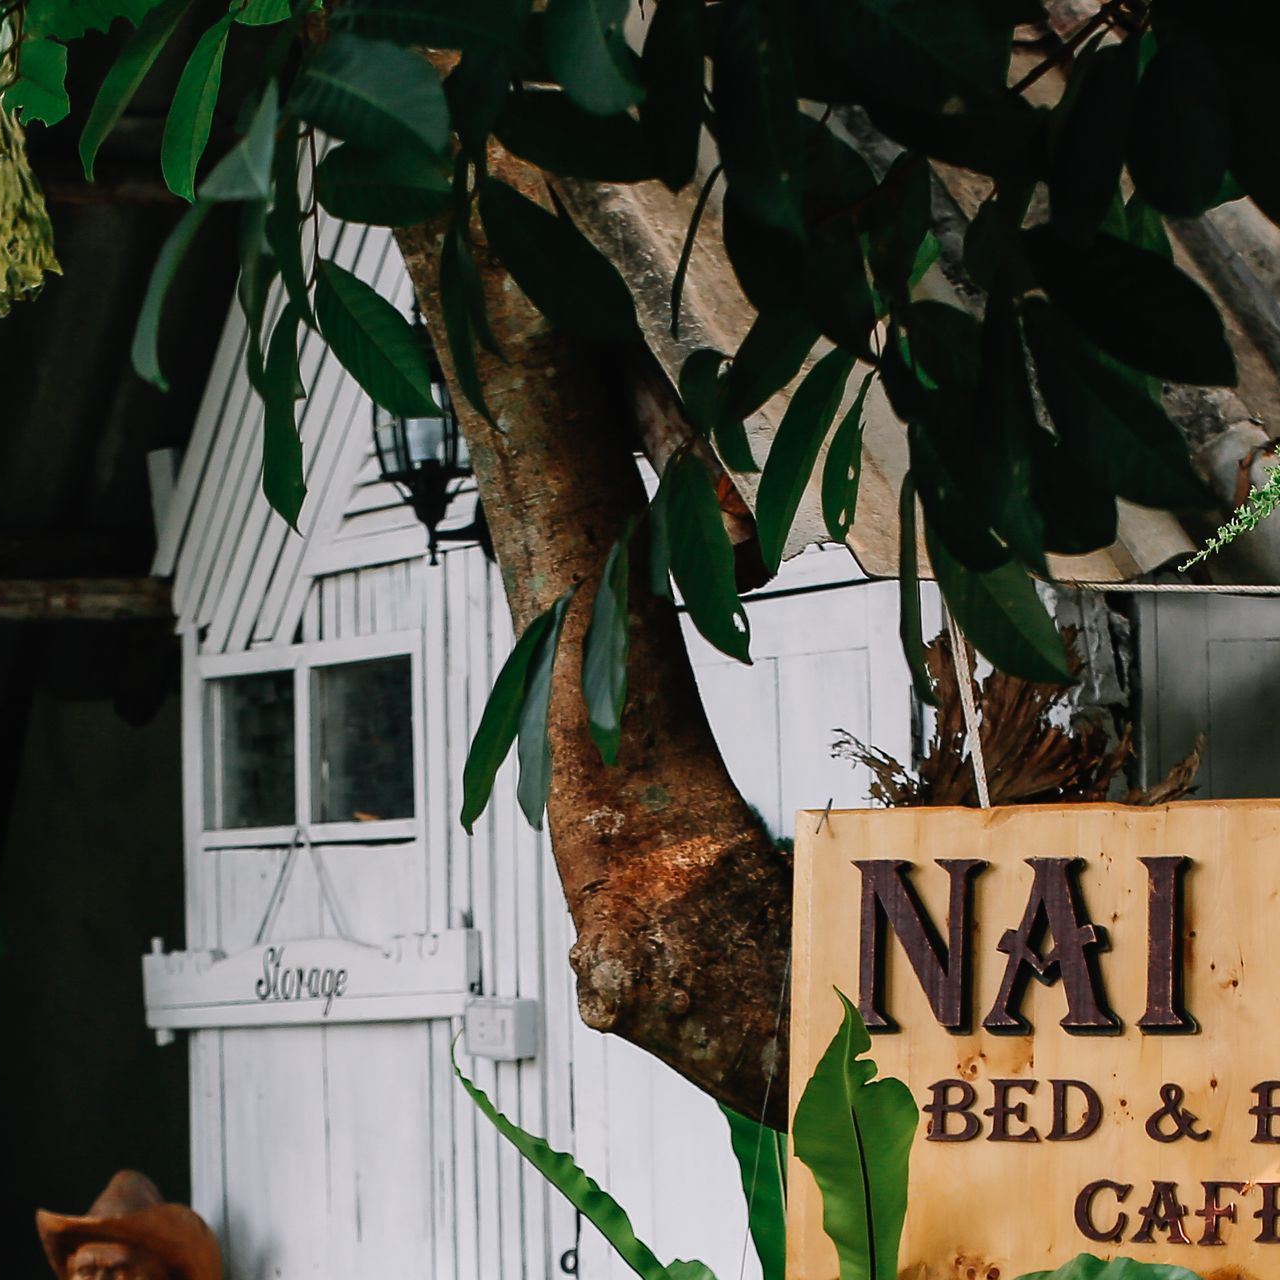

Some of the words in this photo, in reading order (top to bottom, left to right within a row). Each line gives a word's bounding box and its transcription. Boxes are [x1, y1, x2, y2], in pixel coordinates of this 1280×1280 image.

[256, 946, 348, 1016] Storage
[851, 856, 1198, 1036] NAI
[923, 1078, 1104, 1144] BED
[1145, 1082, 1211, 1144] &
